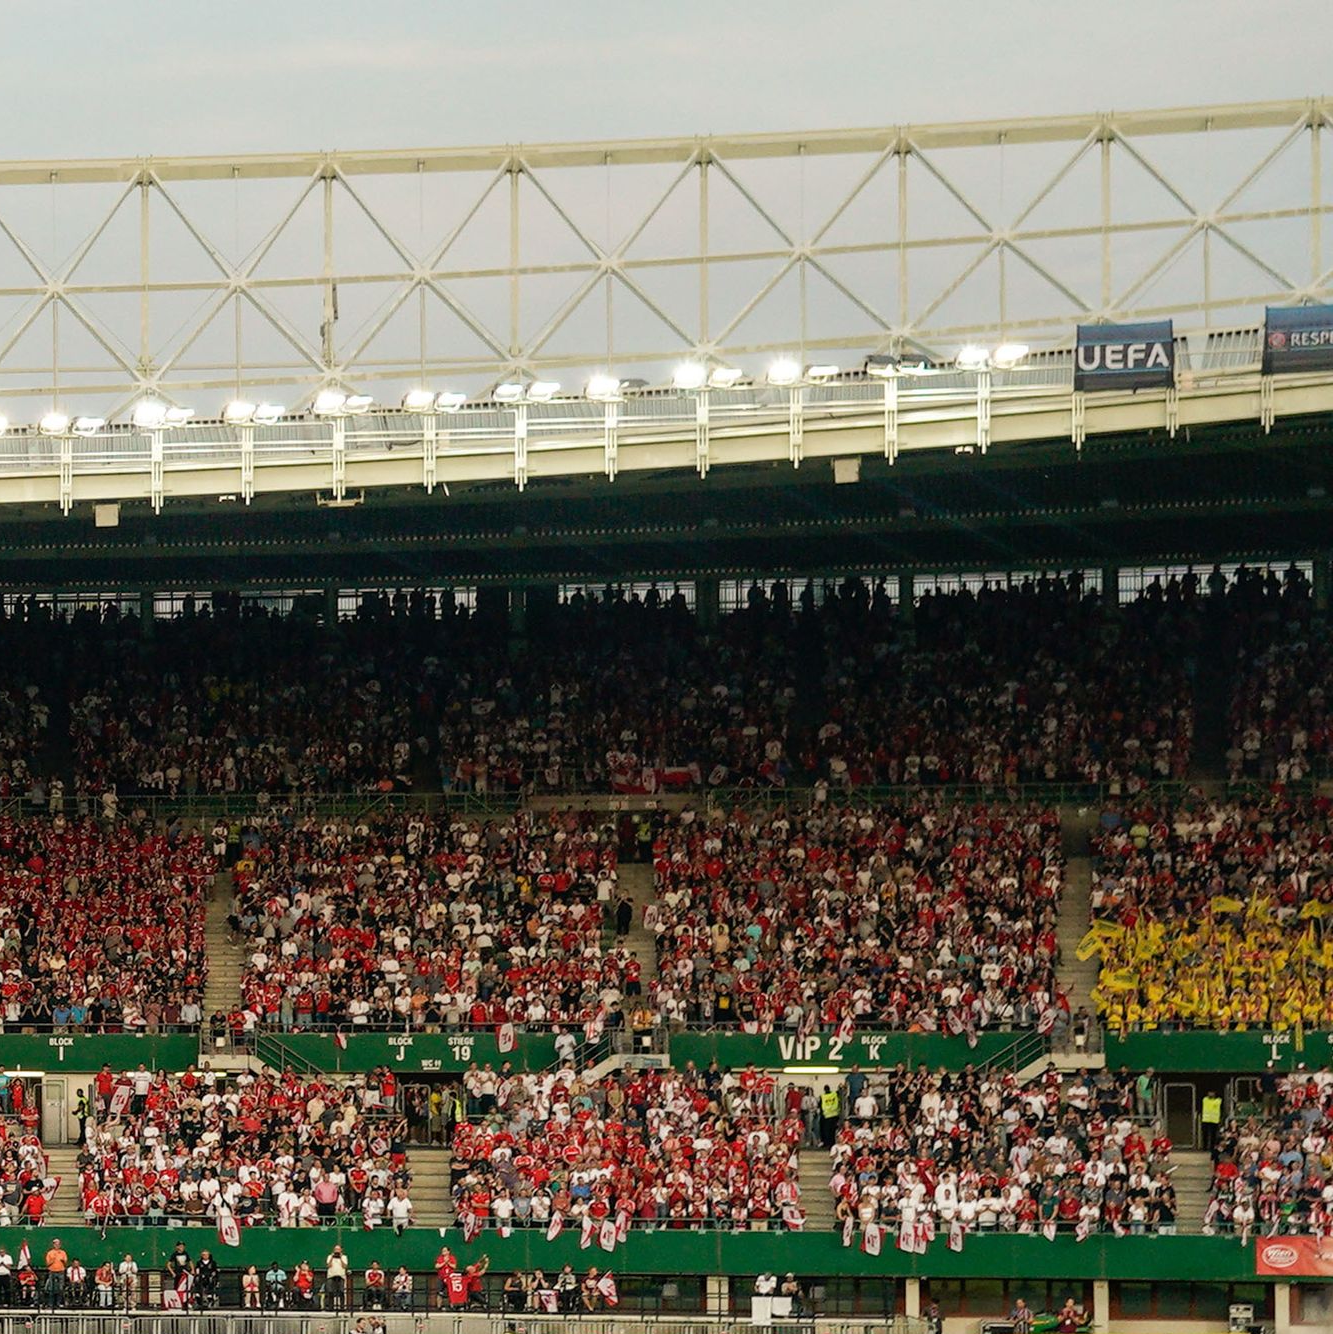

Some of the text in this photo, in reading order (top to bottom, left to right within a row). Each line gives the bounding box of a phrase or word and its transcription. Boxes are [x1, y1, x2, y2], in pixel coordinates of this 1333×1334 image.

[1290, 330, 1333, 346] RESP
[1078, 343, 1169, 371] UEFA
[49, 1038, 73, 1046] BLOCK
[388, 1037, 413, 1045] BLOCK
[448, 1037, 474, 1045] STIEGE
[778, 1036, 844, 1060] VIP 2
[453, 1046, 471, 1060] 19
